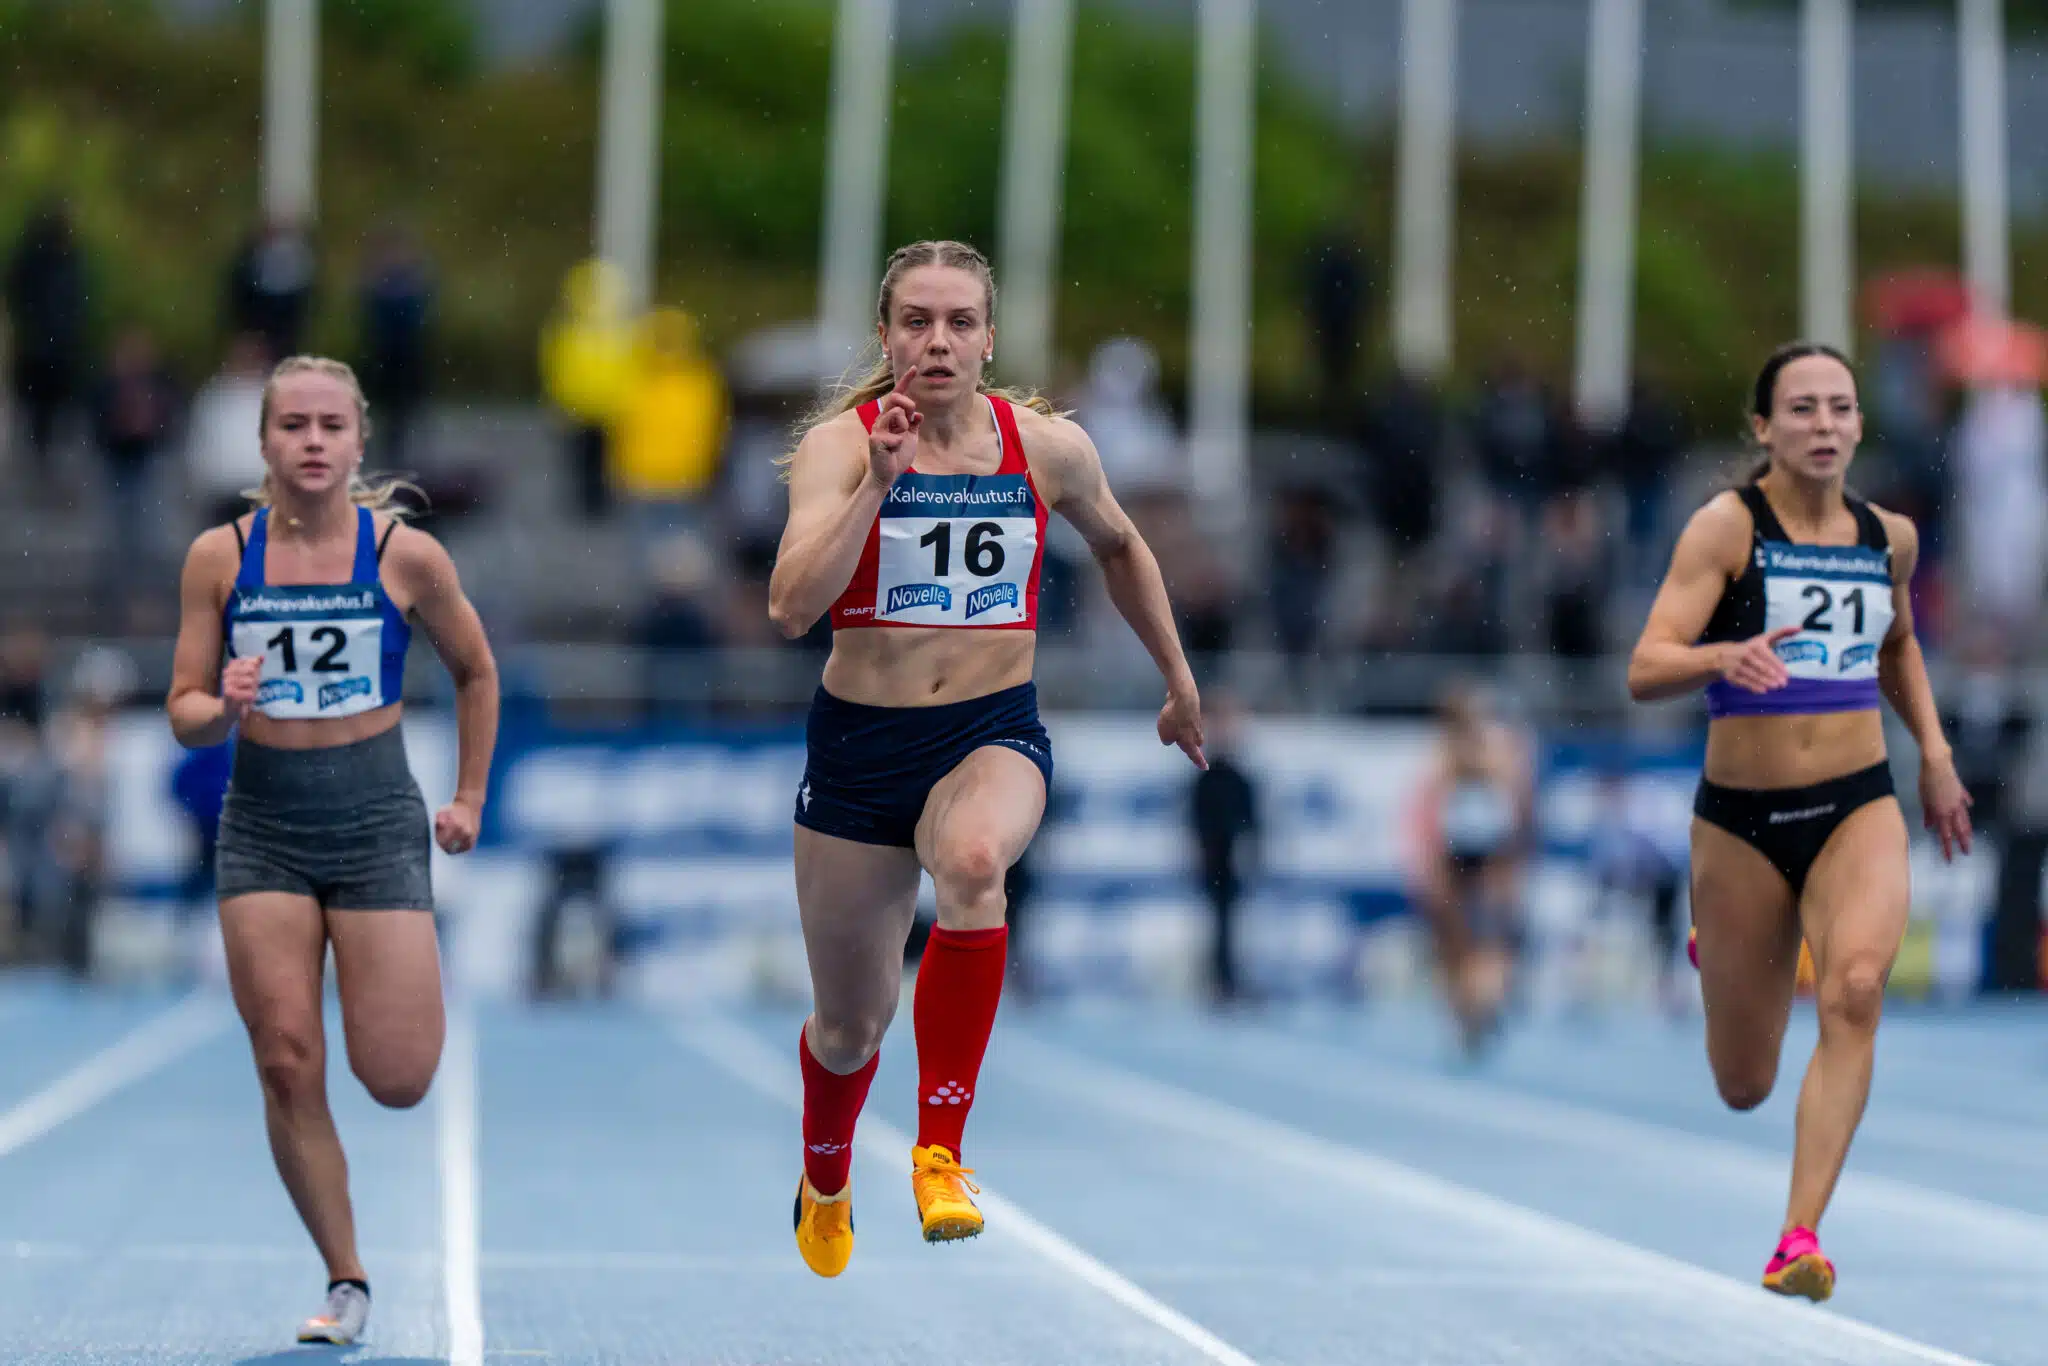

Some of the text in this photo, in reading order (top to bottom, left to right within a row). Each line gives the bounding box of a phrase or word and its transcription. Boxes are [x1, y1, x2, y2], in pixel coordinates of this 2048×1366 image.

[889, 486, 1027, 504] Kalevavakuutus.fi
[920, 521, 1005, 577] 16
[843, 606, 876, 617] CRAFT
[890, 585, 946, 610] Novelle
[969, 584, 1014, 614] Novelle
[1802, 585, 1864, 635] 21
[267, 626, 349, 673] 12
